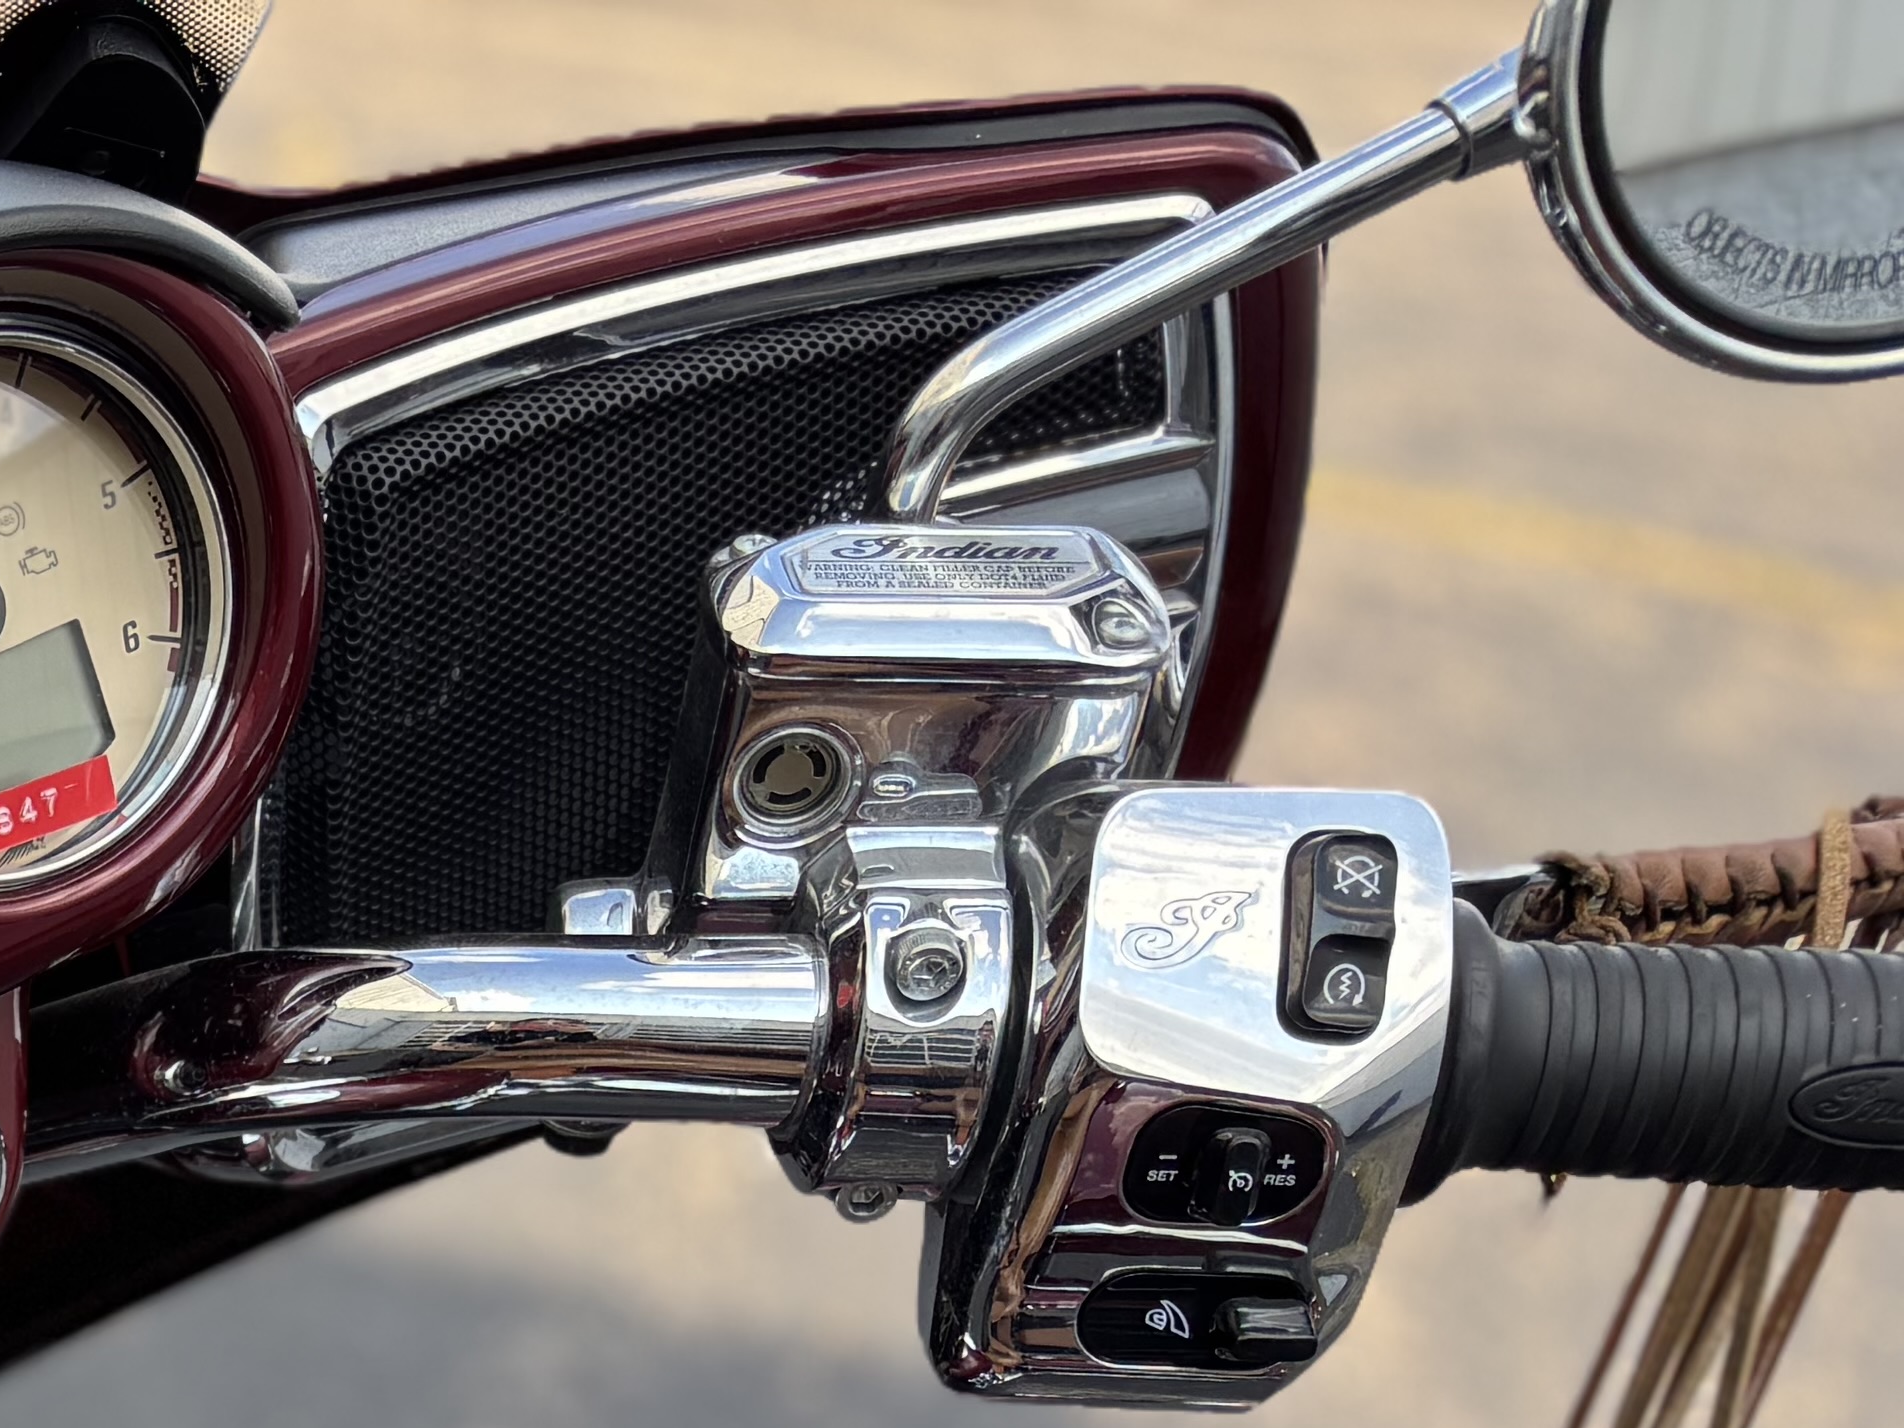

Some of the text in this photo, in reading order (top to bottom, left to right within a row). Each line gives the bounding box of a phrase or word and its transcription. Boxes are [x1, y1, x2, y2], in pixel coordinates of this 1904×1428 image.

[1685, 207, 1788, 286] OBJECTS
[101, 480, 117, 510] 5
[830, 536, 1059, 561] Indian
[799, 563, 875, 573] WARNING:
[879, 563, 929, 573] CLEAN
[902, 572, 932, 581] USE
[935, 572, 975, 581] ONLY
[836, 580, 1048, 590] FROM A SEALED CONTAINER
[122, 620, 140, 654] 6
[1146, 1169, 1179, 1182] SET
[1263, 1173, 1297, 1187] RES
